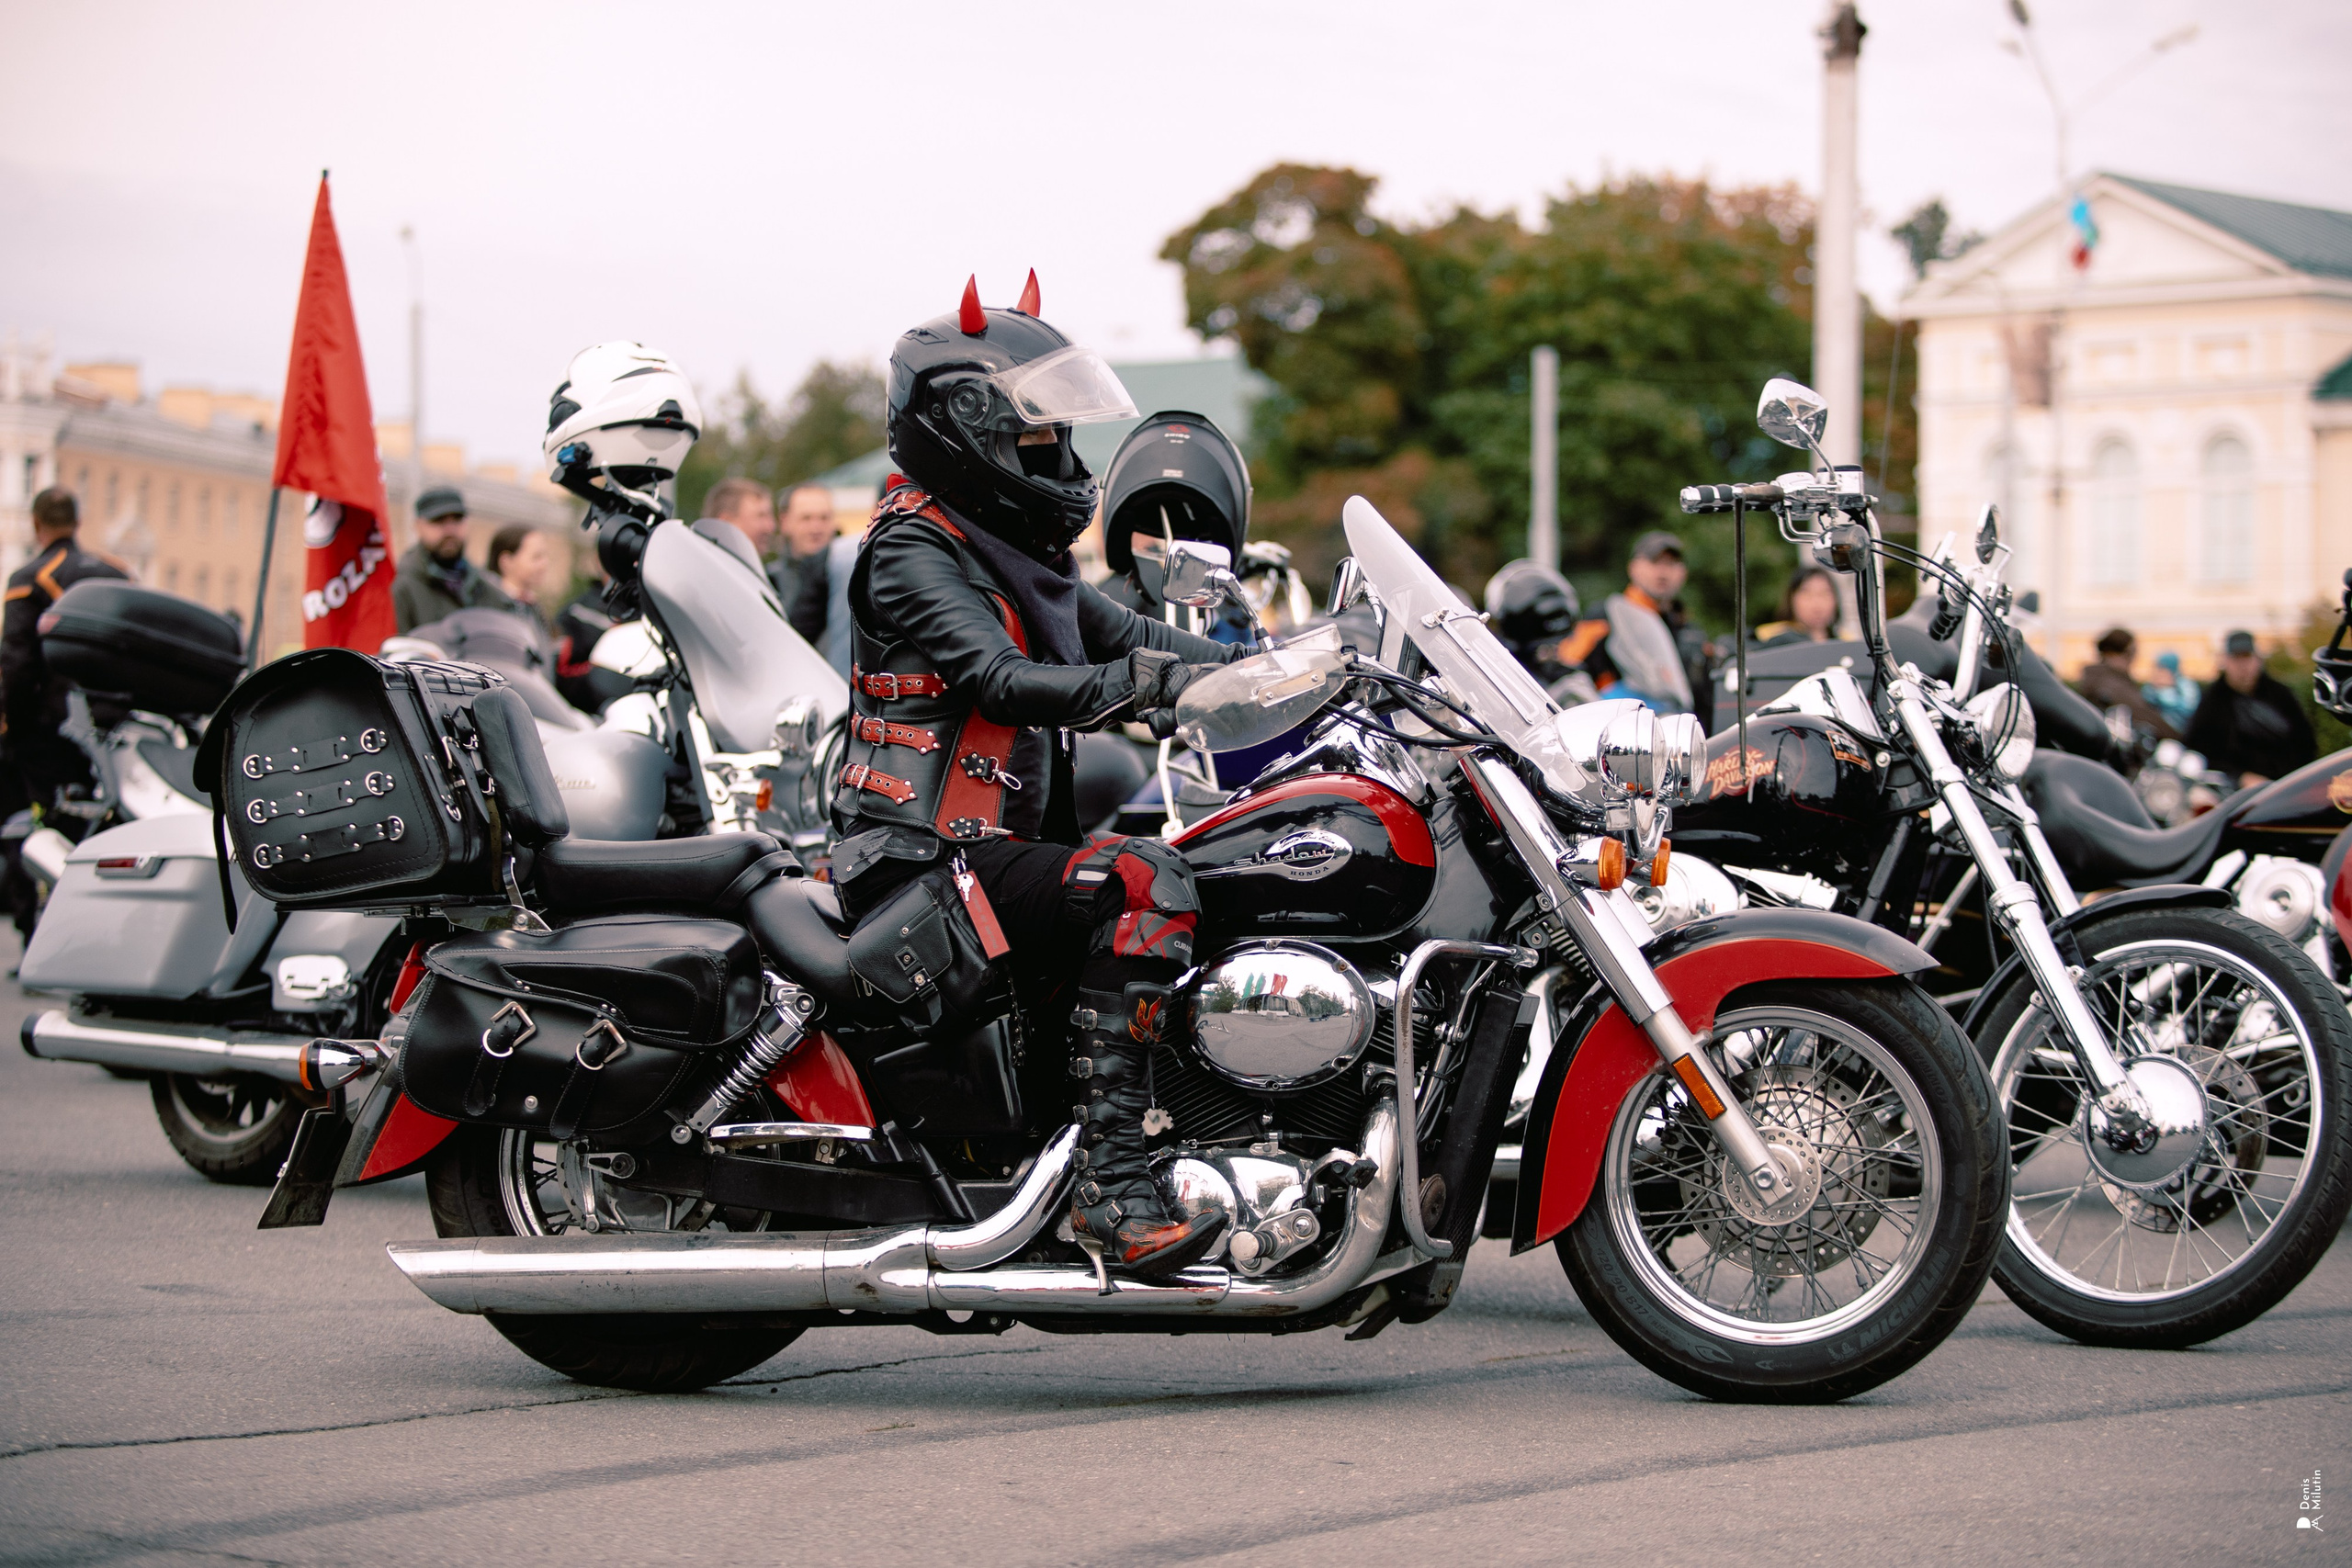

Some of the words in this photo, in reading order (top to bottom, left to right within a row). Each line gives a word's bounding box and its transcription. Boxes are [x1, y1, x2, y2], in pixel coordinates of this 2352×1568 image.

[1290, 865, 1329, 876] HONDA
[1625, 1294, 1649, 1316] B17
[1859, 1245, 1951, 1348] MICHELIN
